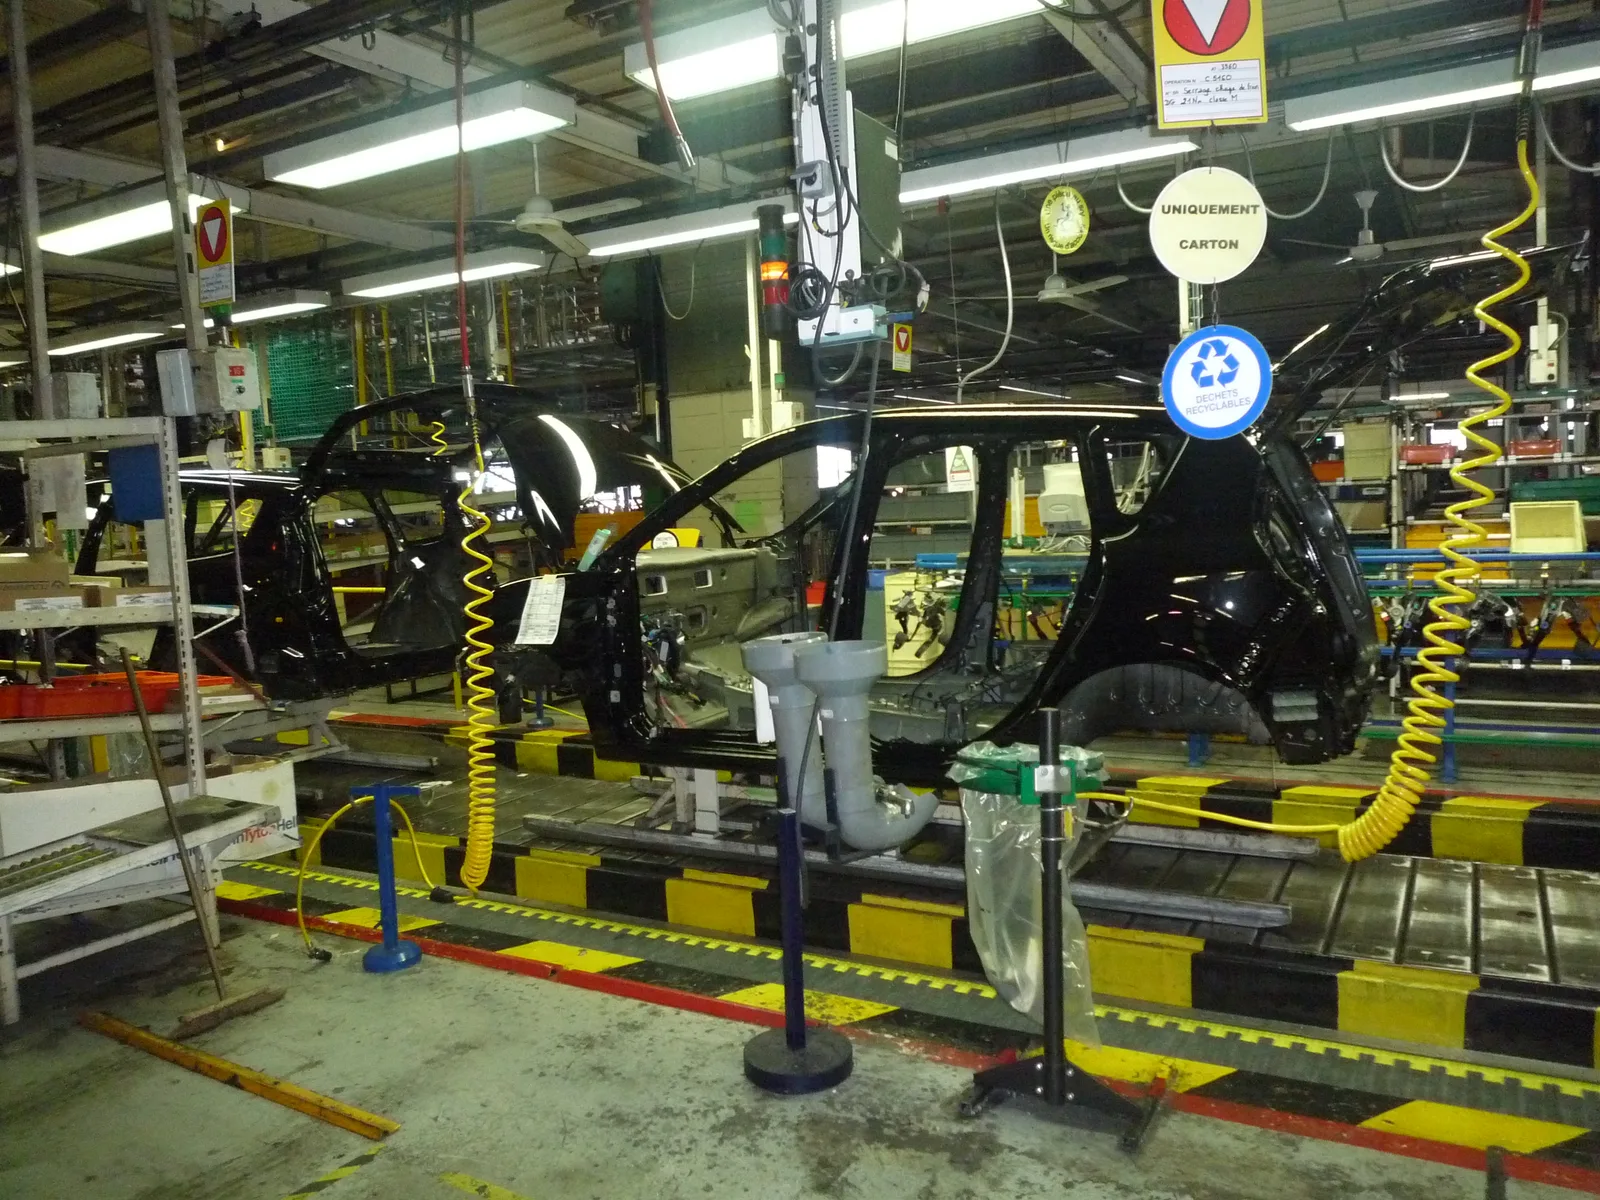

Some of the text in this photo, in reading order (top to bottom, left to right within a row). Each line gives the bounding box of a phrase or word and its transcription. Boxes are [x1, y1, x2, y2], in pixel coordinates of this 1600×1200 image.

[1161, 204, 1260, 215] UNIQUEMENT
[1179, 239, 1239, 250] CARTON
[1195, 388, 1239, 404] DECHETS
[1185, 396, 1251, 416] RECYCLABLES
